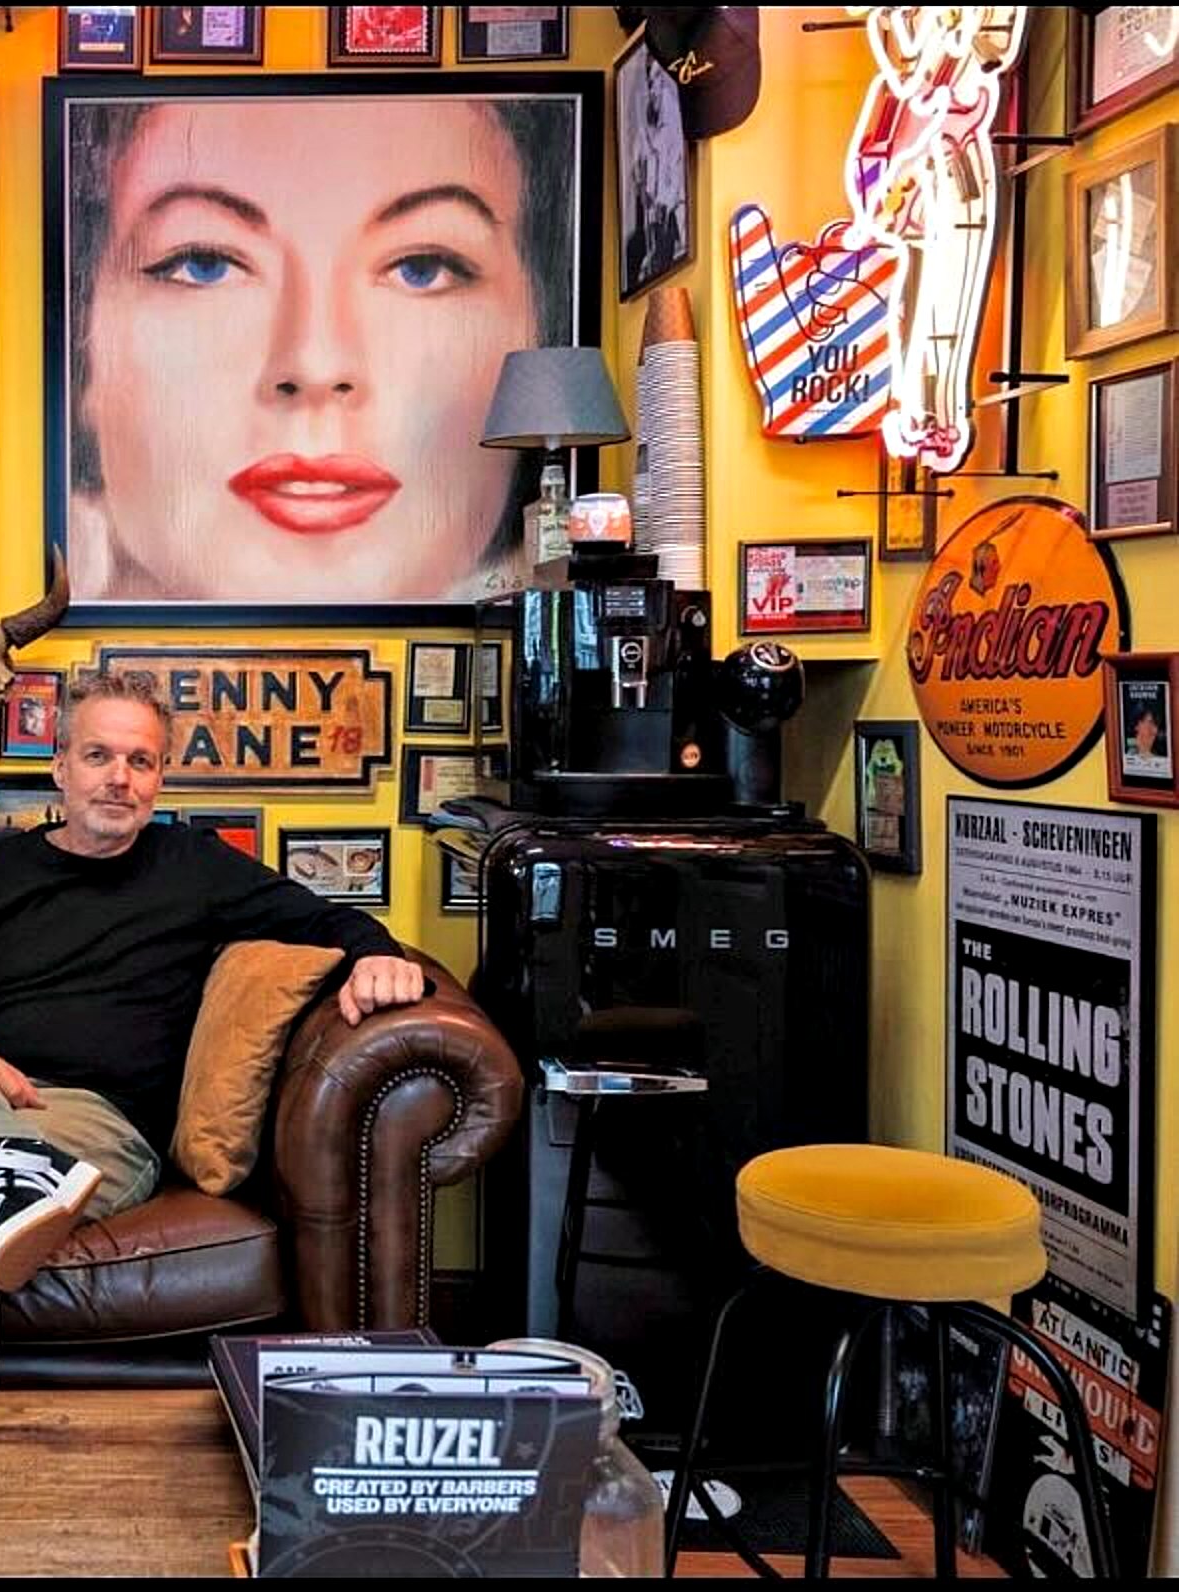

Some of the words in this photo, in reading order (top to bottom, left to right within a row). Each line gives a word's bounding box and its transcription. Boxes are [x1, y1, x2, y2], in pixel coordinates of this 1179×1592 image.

[807, 343, 858, 373] YOU
[791, 373, 869, 403] ROCK!
[752, 597, 794, 613] VIP
[907, 571, 1109, 684] Indian
[170, 670, 345, 711] ENNY
[960, 697, 1022, 714] AMERICA'S
[983, 721, 1067, 739] MOTORCYCLE
[164, 725, 321, 767] ANE
[329, 725, 363, 754] 18
[955, 813, 1008, 844] KURZAAL
[1022, 820, 1133, 862] SCHEVENINGEN
[593, 926, 790, 949] SMEG
[962, 938, 992, 961] THE
[961, 965, 1121, 1088] ROLLING
[966, 1054, 1114, 1185] STONES
[1039, 1308, 1133, 1384] ATLANTIC
[354, 1415, 502, 1467] REUZEL
[313, 1477, 408, 1496] CREATED
[410, 1479, 440, 1495] BY
[440, 1479, 537, 1496] BARBERS
[326, 1497, 381, 1514] USED
[383, 1497, 413, 1513] BY
[413, 1497, 521, 1513] EVERYONE
